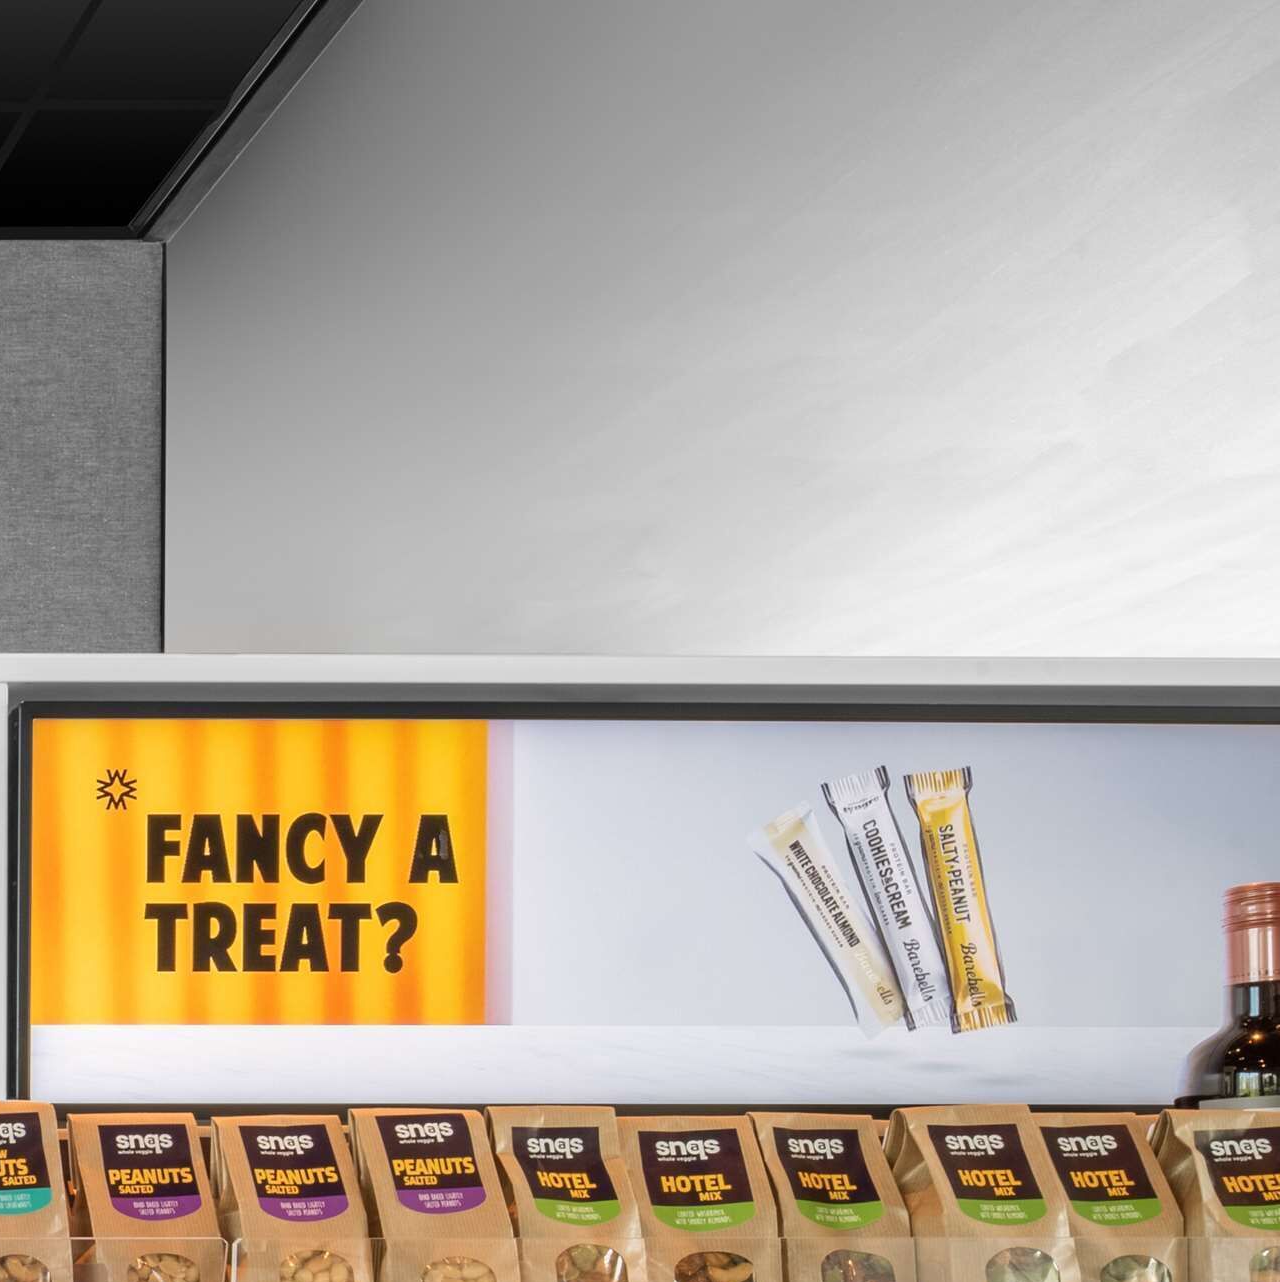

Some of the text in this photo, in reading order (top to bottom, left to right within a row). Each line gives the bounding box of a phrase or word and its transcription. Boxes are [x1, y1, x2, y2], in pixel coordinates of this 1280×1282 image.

[147, 814, 457, 884] FANCY A
[939, 824, 970, 923] SALTY PEANUT
[789, 840, 860, 948] WHITE CHOCOLATE ALMOND
[145, 902, 418, 973] TREAT?
[903, 939, 932, 1002] Barebells
[961, 942, 982, 1008] Barebells
[392, 1156, 475, 1176] PEANUTS
[2, 1175, 37, 1186] SALTED
[108, 1167, 193, 1185] PEANUTS
[254, 1166, 338, 1185] PEANUTS
[403, 1174, 437, 1186] SALTED
[537, 1170, 597, 1189] HOTEL
[661, 1174, 732, 1193] HOTEL
[798, 1171, 857, 1190] HOTEL
[957, 1169, 1022, 1187] HOTEL
[1069, 1170, 1135, 1187] HOTEL
[118, 1184, 154, 1195] SALTED
[265, 1184, 299, 1195] SALTED
[569, 1189, 590, 1199] MIX
[699, 1190, 723, 1201] MIX
[993, 1187, 1016, 1196] MIX
[1107, 1187, 1130, 1197] MIX
